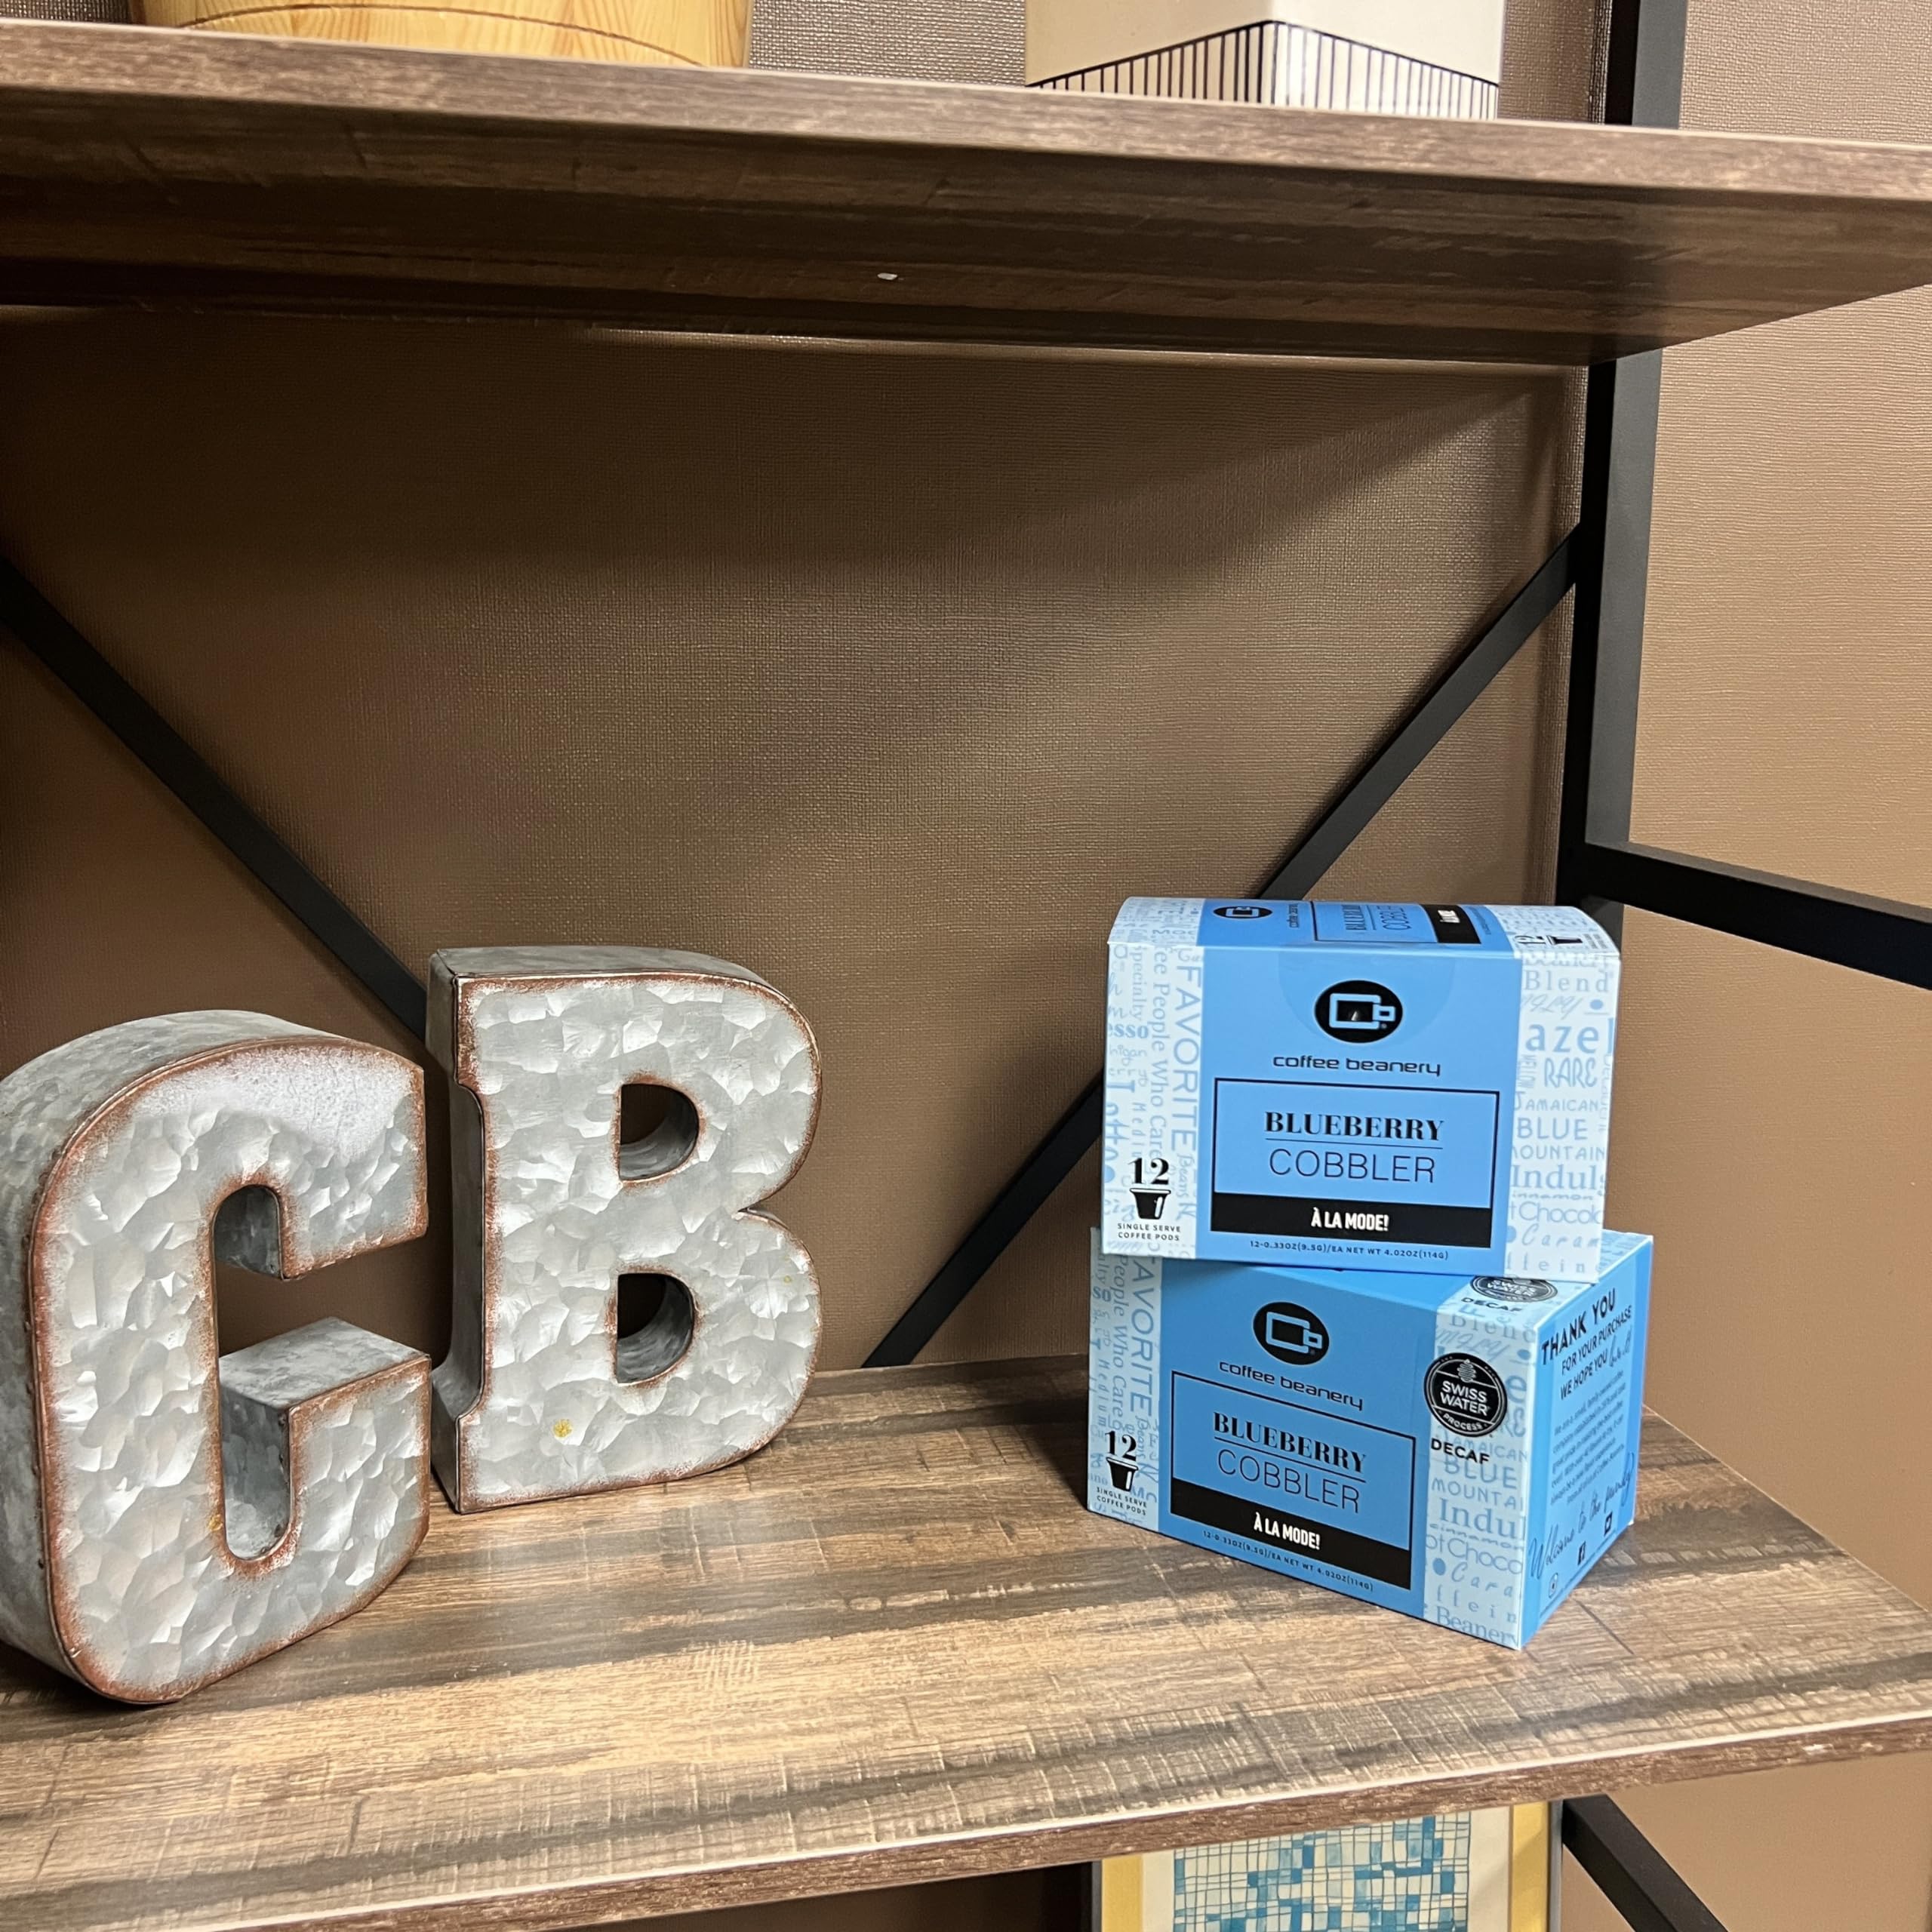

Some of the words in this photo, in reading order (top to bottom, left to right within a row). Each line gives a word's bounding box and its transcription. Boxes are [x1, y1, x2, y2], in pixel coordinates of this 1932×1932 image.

[1524, 969, 1609, 993] Blend
[1147, 983, 1171, 1051] People
[1171, 965, 1202, 1151] FAVORITE
[1273, 1055, 1340, 1069] coffee
[1346, 1057, 1441, 1077] beanery
[1150, 1060, 1170, 1107] Who
[1514, 1091, 1599, 1112] JAMAICAN
[1265, 1111, 1444, 1142] BLUEBERRY
[1517, 1117, 1588, 1140] BLUE
[1128, 1157, 1170, 1185] 12
[1269, 1148, 1435, 1183] COBBLER
[1117, 1223, 1150, 1232] SINGLE
[1153, 1224, 1181, 1233] SERVE
[1311, 1207, 1321, 1228] À
[1324, 1211, 1343, 1229] LA
[1345, 1212, 1389, 1232] MODE!
[1118, 1232, 1152, 1240] COFFEE
[1155, 1232, 1180, 1241] PODS
[1346, 1247, 1364, 1255] NET
[1367, 1247, 1381, 1256] WT
[1542, 1311, 1587, 1365] THANK
[1592, 1287, 1616, 1325] YOU
[1561, 1352, 1577, 1376] FOR
[1578, 1335, 1597, 1362] YOUR
[1219, 1361, 1275, 1385] coffee
[1280, 1376, 1364, 1411] beanery
[1560, 1379, 1572, 1401] WE
[1574, 1361, 1593, 1390] HOPE
[1594, 1348, 1608, 1372] YOU
[1440, 1392, 1488, 1417] WATER
[1441, 1380, 1487, 1404] SWISS
[1442, 1412, 1484, 1432] PROCESS
[1105, 1430, 1137, 1462] 12
[1213, 1411, 1367, 1474] BLUEBERRY
[1430, 1437, 1491, 1465] DECAF
[1217, 1448, 1360, 1514] COBBLER
[1444, 1454, 1518, 1490] BLUE
[1097, 1486, 1122, 1501] SINGLE
[1124, 1496, 1147, 1509] SERVE
[1097, 1495, 1124, 1509] COFFEE
[1126, 1505, 1147, 1516] PODS
[1253, 1511, 1263, 1532] À
[1265, 1517, 1281, 1538] LA
[1282, 1523, 1321, 1551] MODE!
[1283, 1556, 1300, 1567] NET
